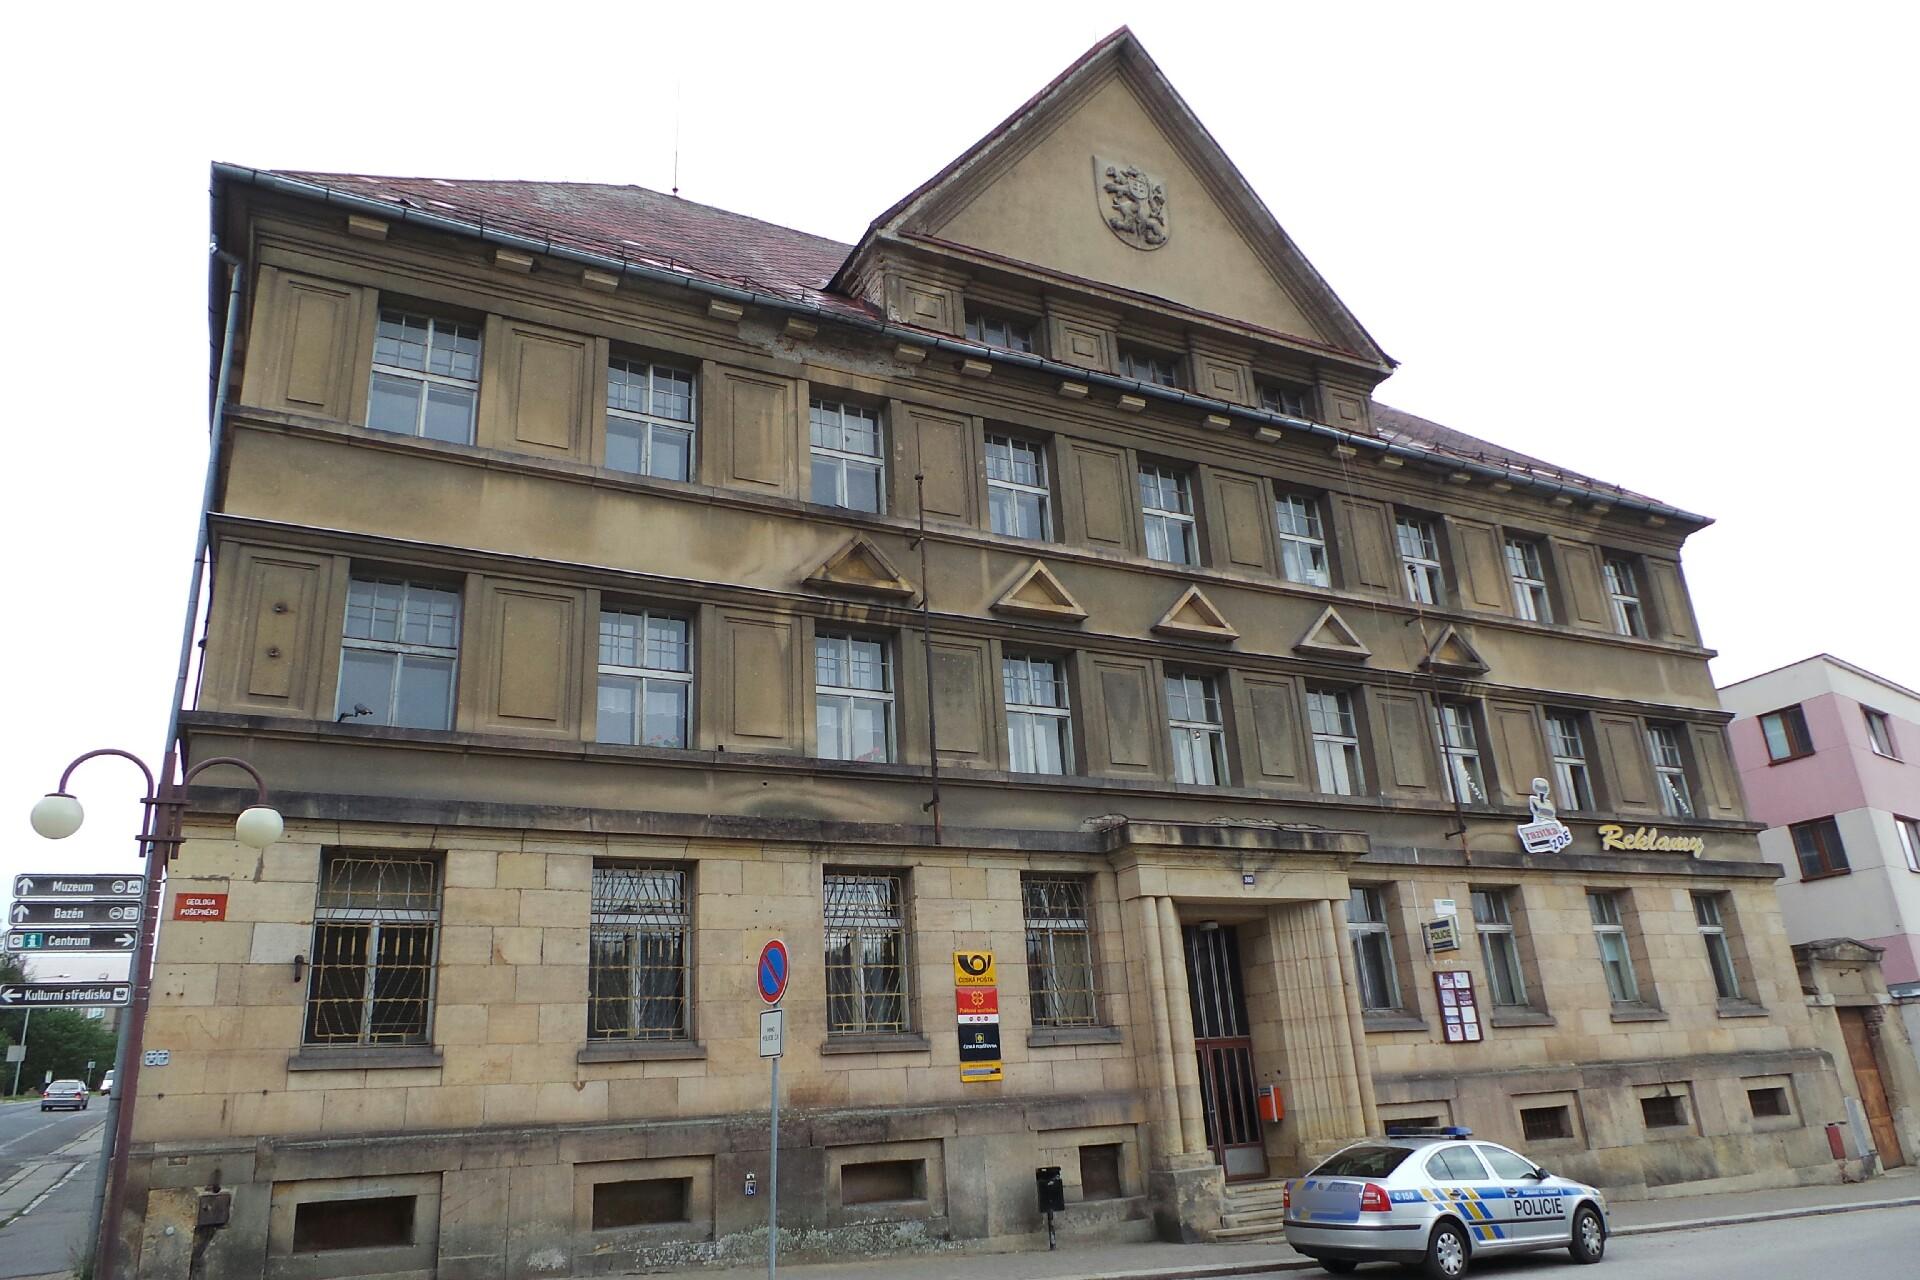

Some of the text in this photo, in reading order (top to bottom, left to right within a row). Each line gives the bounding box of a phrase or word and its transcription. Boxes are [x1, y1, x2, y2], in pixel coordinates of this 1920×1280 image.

[1551, 830, 1571, 850] ZDE
[1598, 824, 1704, 858] Reklamy
[52, 881, 94, 892] Muzeum
[53, 907, 84, 919] Bazén
[48, 935, 91, 946] Centrum
[24, 988, 111, 1001] Kulturní středisko
[1513, 1198, 1564, 1217] POLICIE
